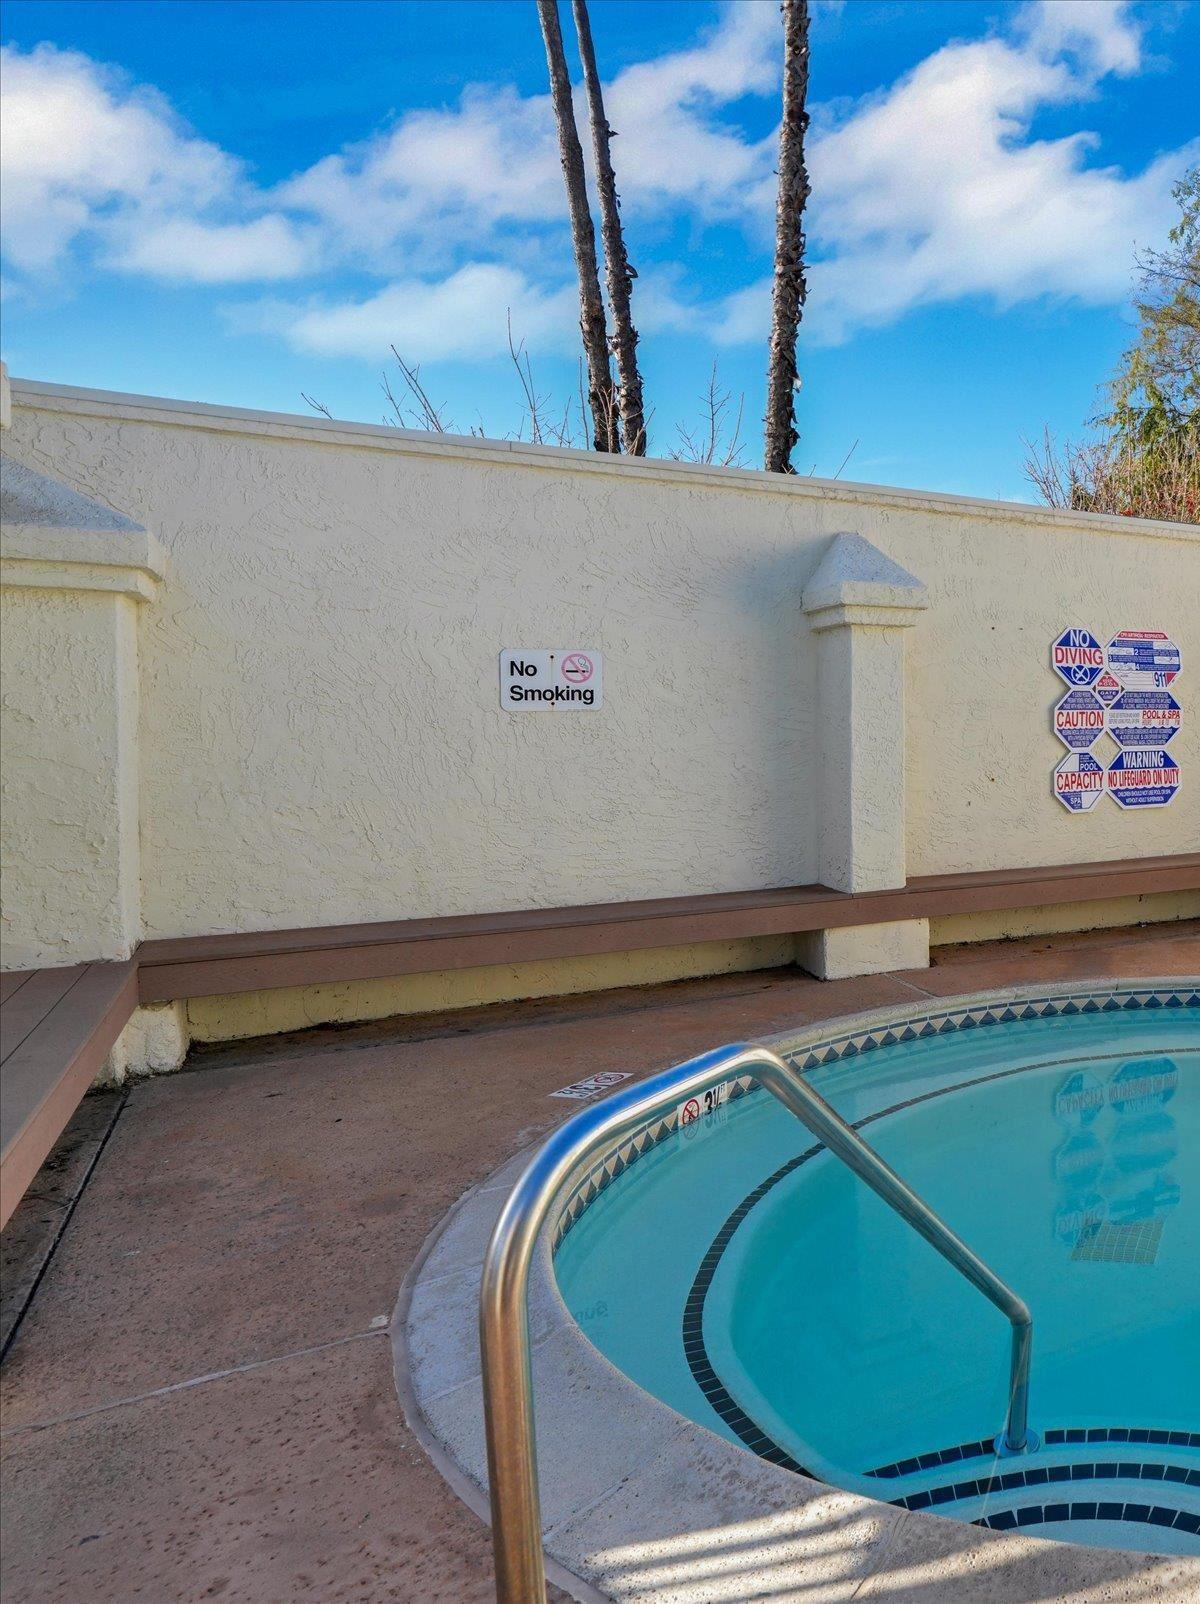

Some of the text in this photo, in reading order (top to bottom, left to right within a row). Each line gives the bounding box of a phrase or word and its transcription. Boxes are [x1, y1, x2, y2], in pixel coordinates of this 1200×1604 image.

[1070, 629, 1090, 647] NO
[1055, 647, 1103, 665] DIVING
[510, 660, 537, 677] No
[1154, 672, 1168, 687] 911
[510, 685, 594, 705] Smoking
[1057, 711, 1104, 727] CAUTION
[1142, 710, 1161, 719] POOL
[1162, 710, 1167, 719] &
[1168, 710, 1180, 718] SPA
[1080, 762, 1098, 771] POOL
[1123, 751, 1164, 768] WARNING
[1057, 772, 1104, 790] CAPACITY
[1108, 769, 1179, 787] NO LIFEGUARD ON DUTY
